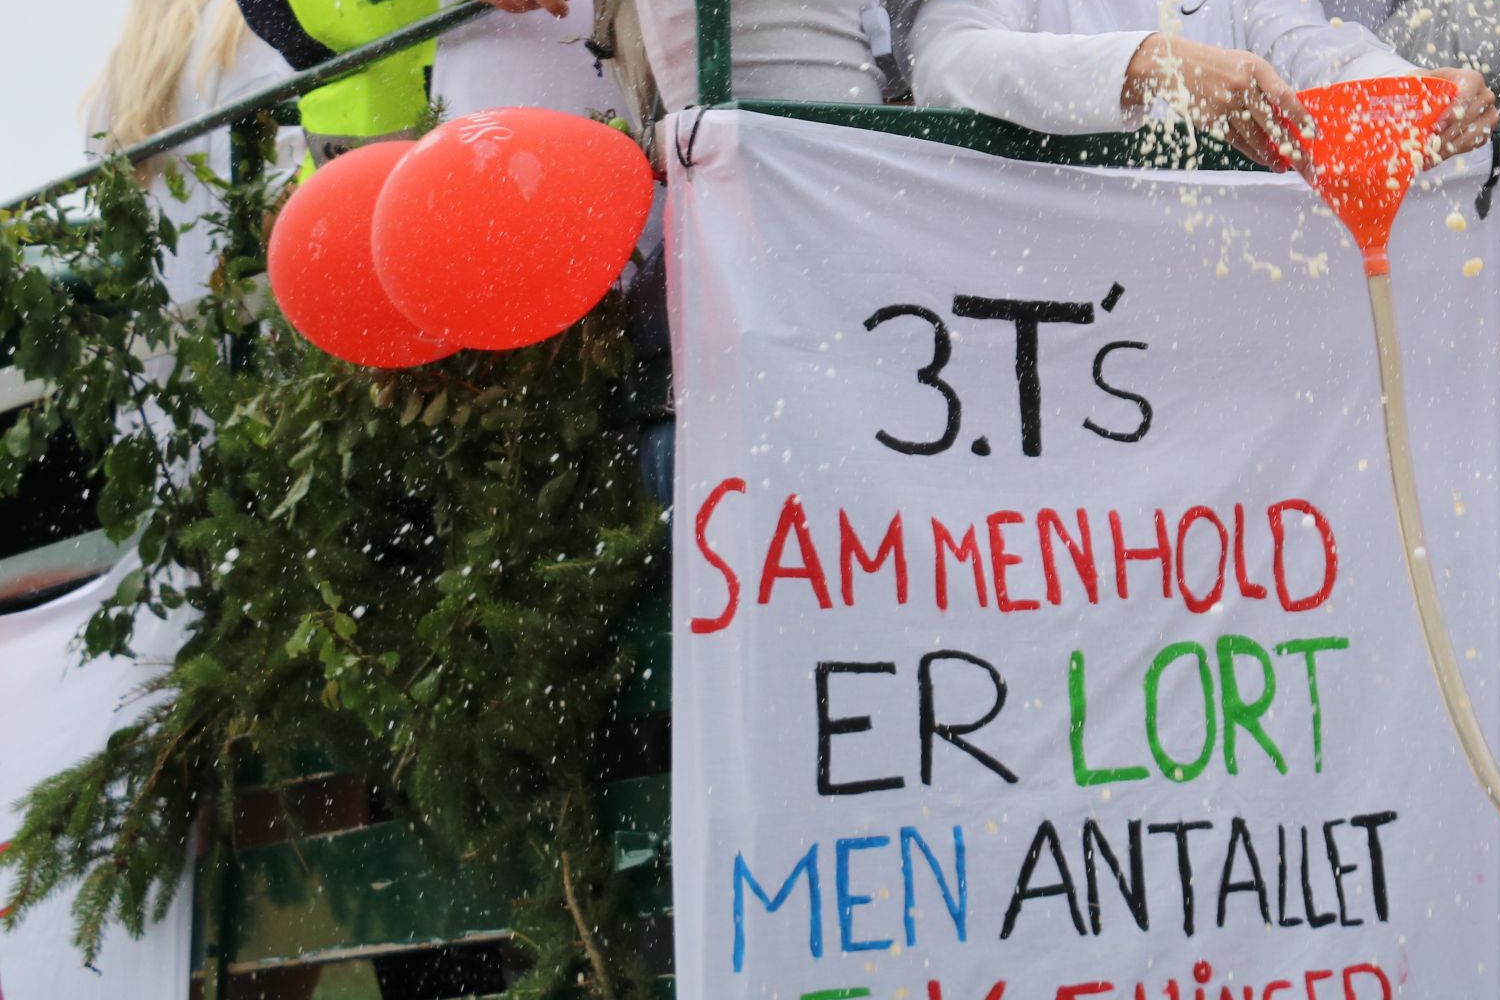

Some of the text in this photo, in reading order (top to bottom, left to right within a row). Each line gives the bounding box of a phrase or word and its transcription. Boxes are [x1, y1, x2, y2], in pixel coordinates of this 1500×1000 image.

[690, 477, 1338, 634] SAMMENHOLD
[816, 635, 1349, 796] ER LORT
[731, 811, 1397, 973] MEN ANTALLET
